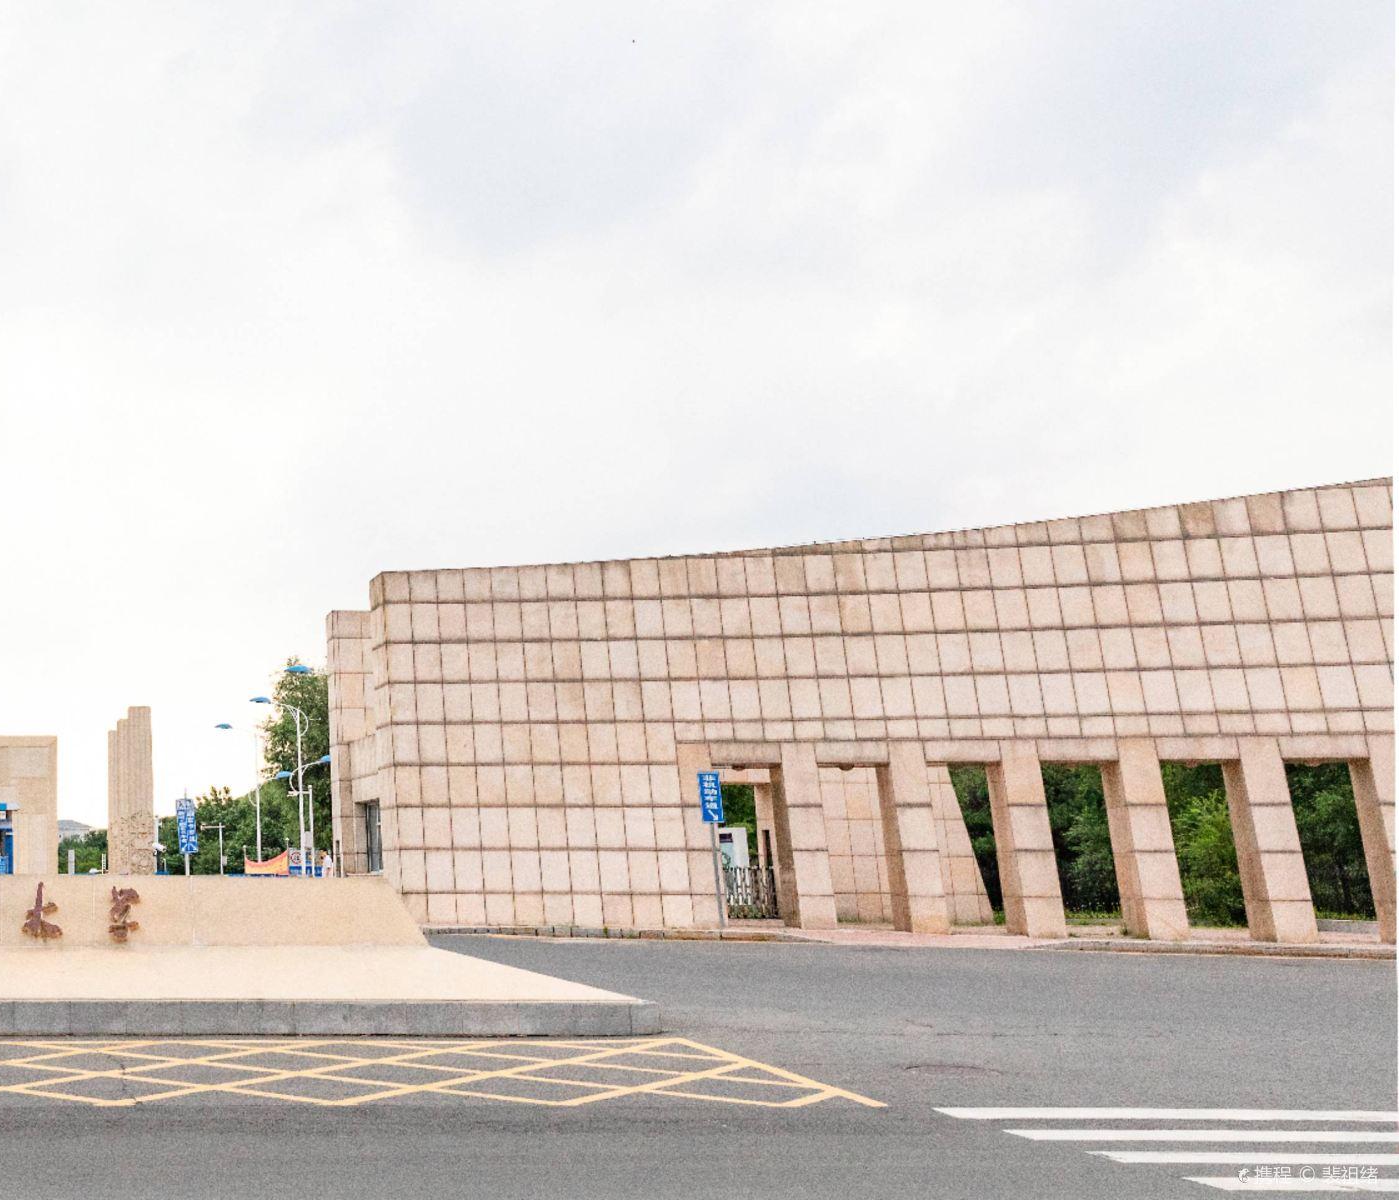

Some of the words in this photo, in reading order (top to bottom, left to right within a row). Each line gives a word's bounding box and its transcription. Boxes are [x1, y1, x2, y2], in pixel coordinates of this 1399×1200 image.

[702, 774, 719, 810] 非机动车道
